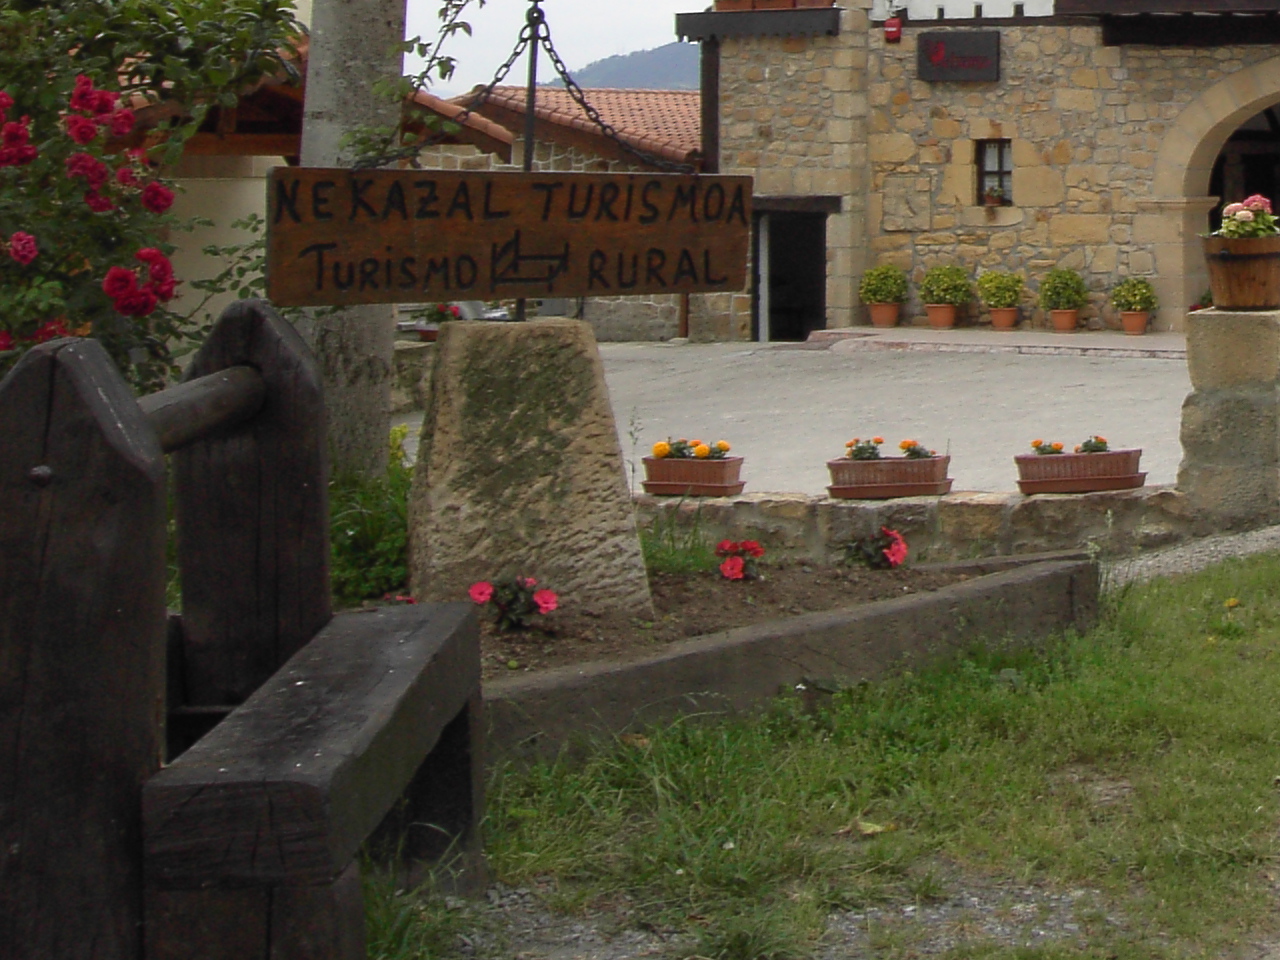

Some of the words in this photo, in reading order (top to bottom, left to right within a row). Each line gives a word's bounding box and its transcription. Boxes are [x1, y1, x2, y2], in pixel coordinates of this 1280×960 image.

[272, 177, 510, 225] NEKAZAL
[531, 175, 748, 225] TURISMOA
[588, 247, 729, 289] RURAL
